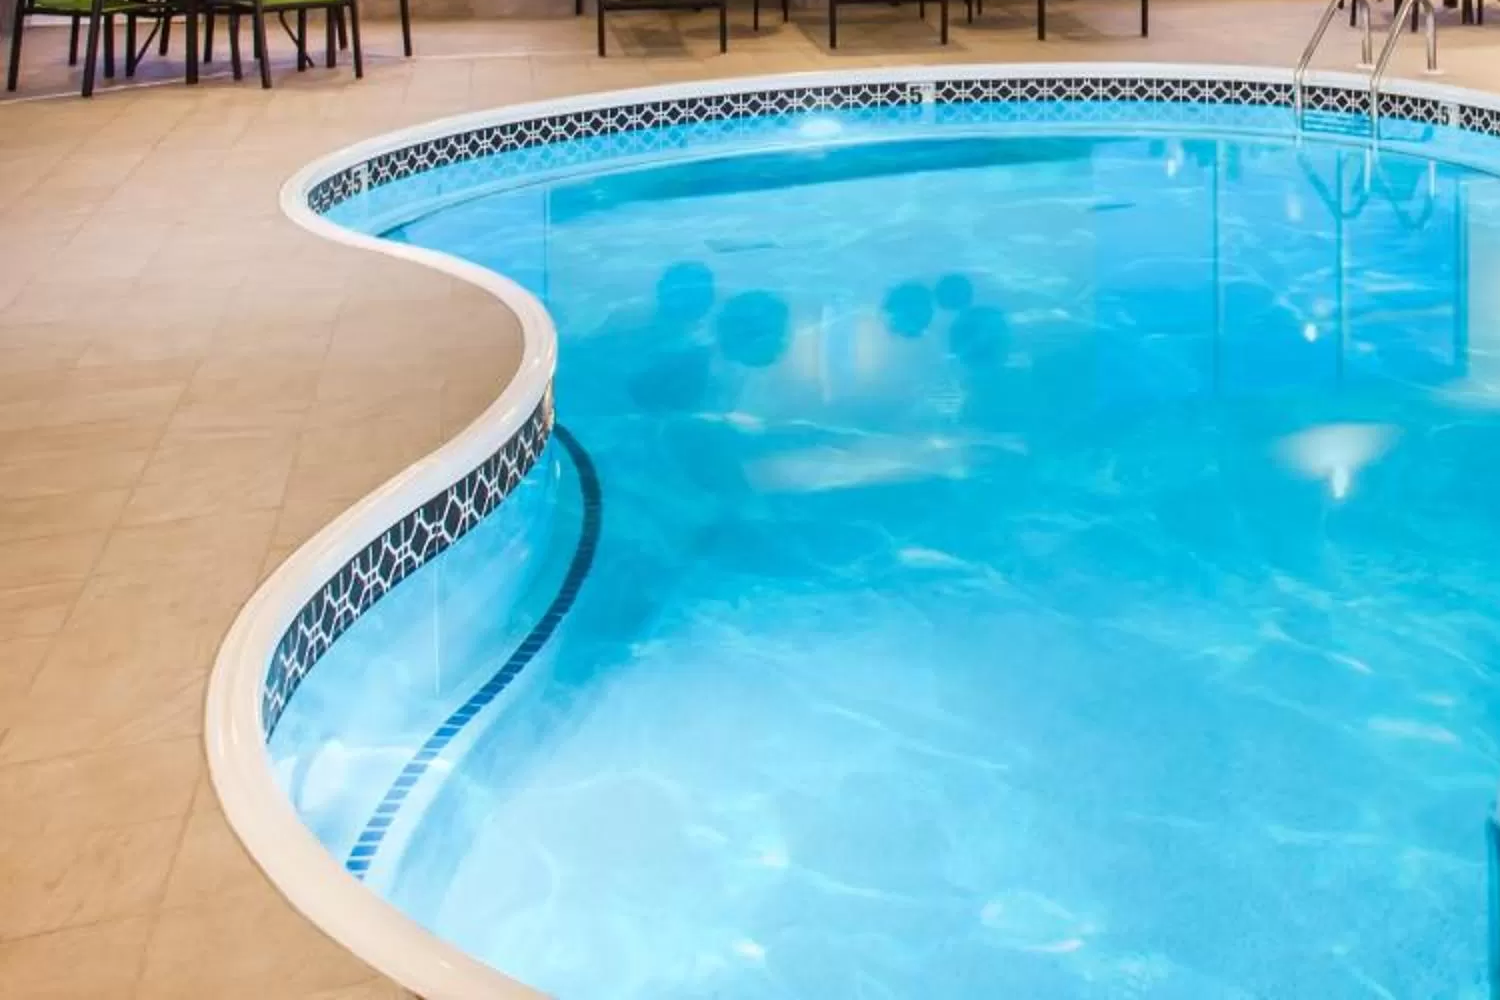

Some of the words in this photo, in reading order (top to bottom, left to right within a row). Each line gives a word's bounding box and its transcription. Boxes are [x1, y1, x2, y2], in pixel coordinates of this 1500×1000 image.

[909, 84, 923, 105] 5
[1441, 105, 1450, 126] 5
[353, 170, 362, 194] 5
